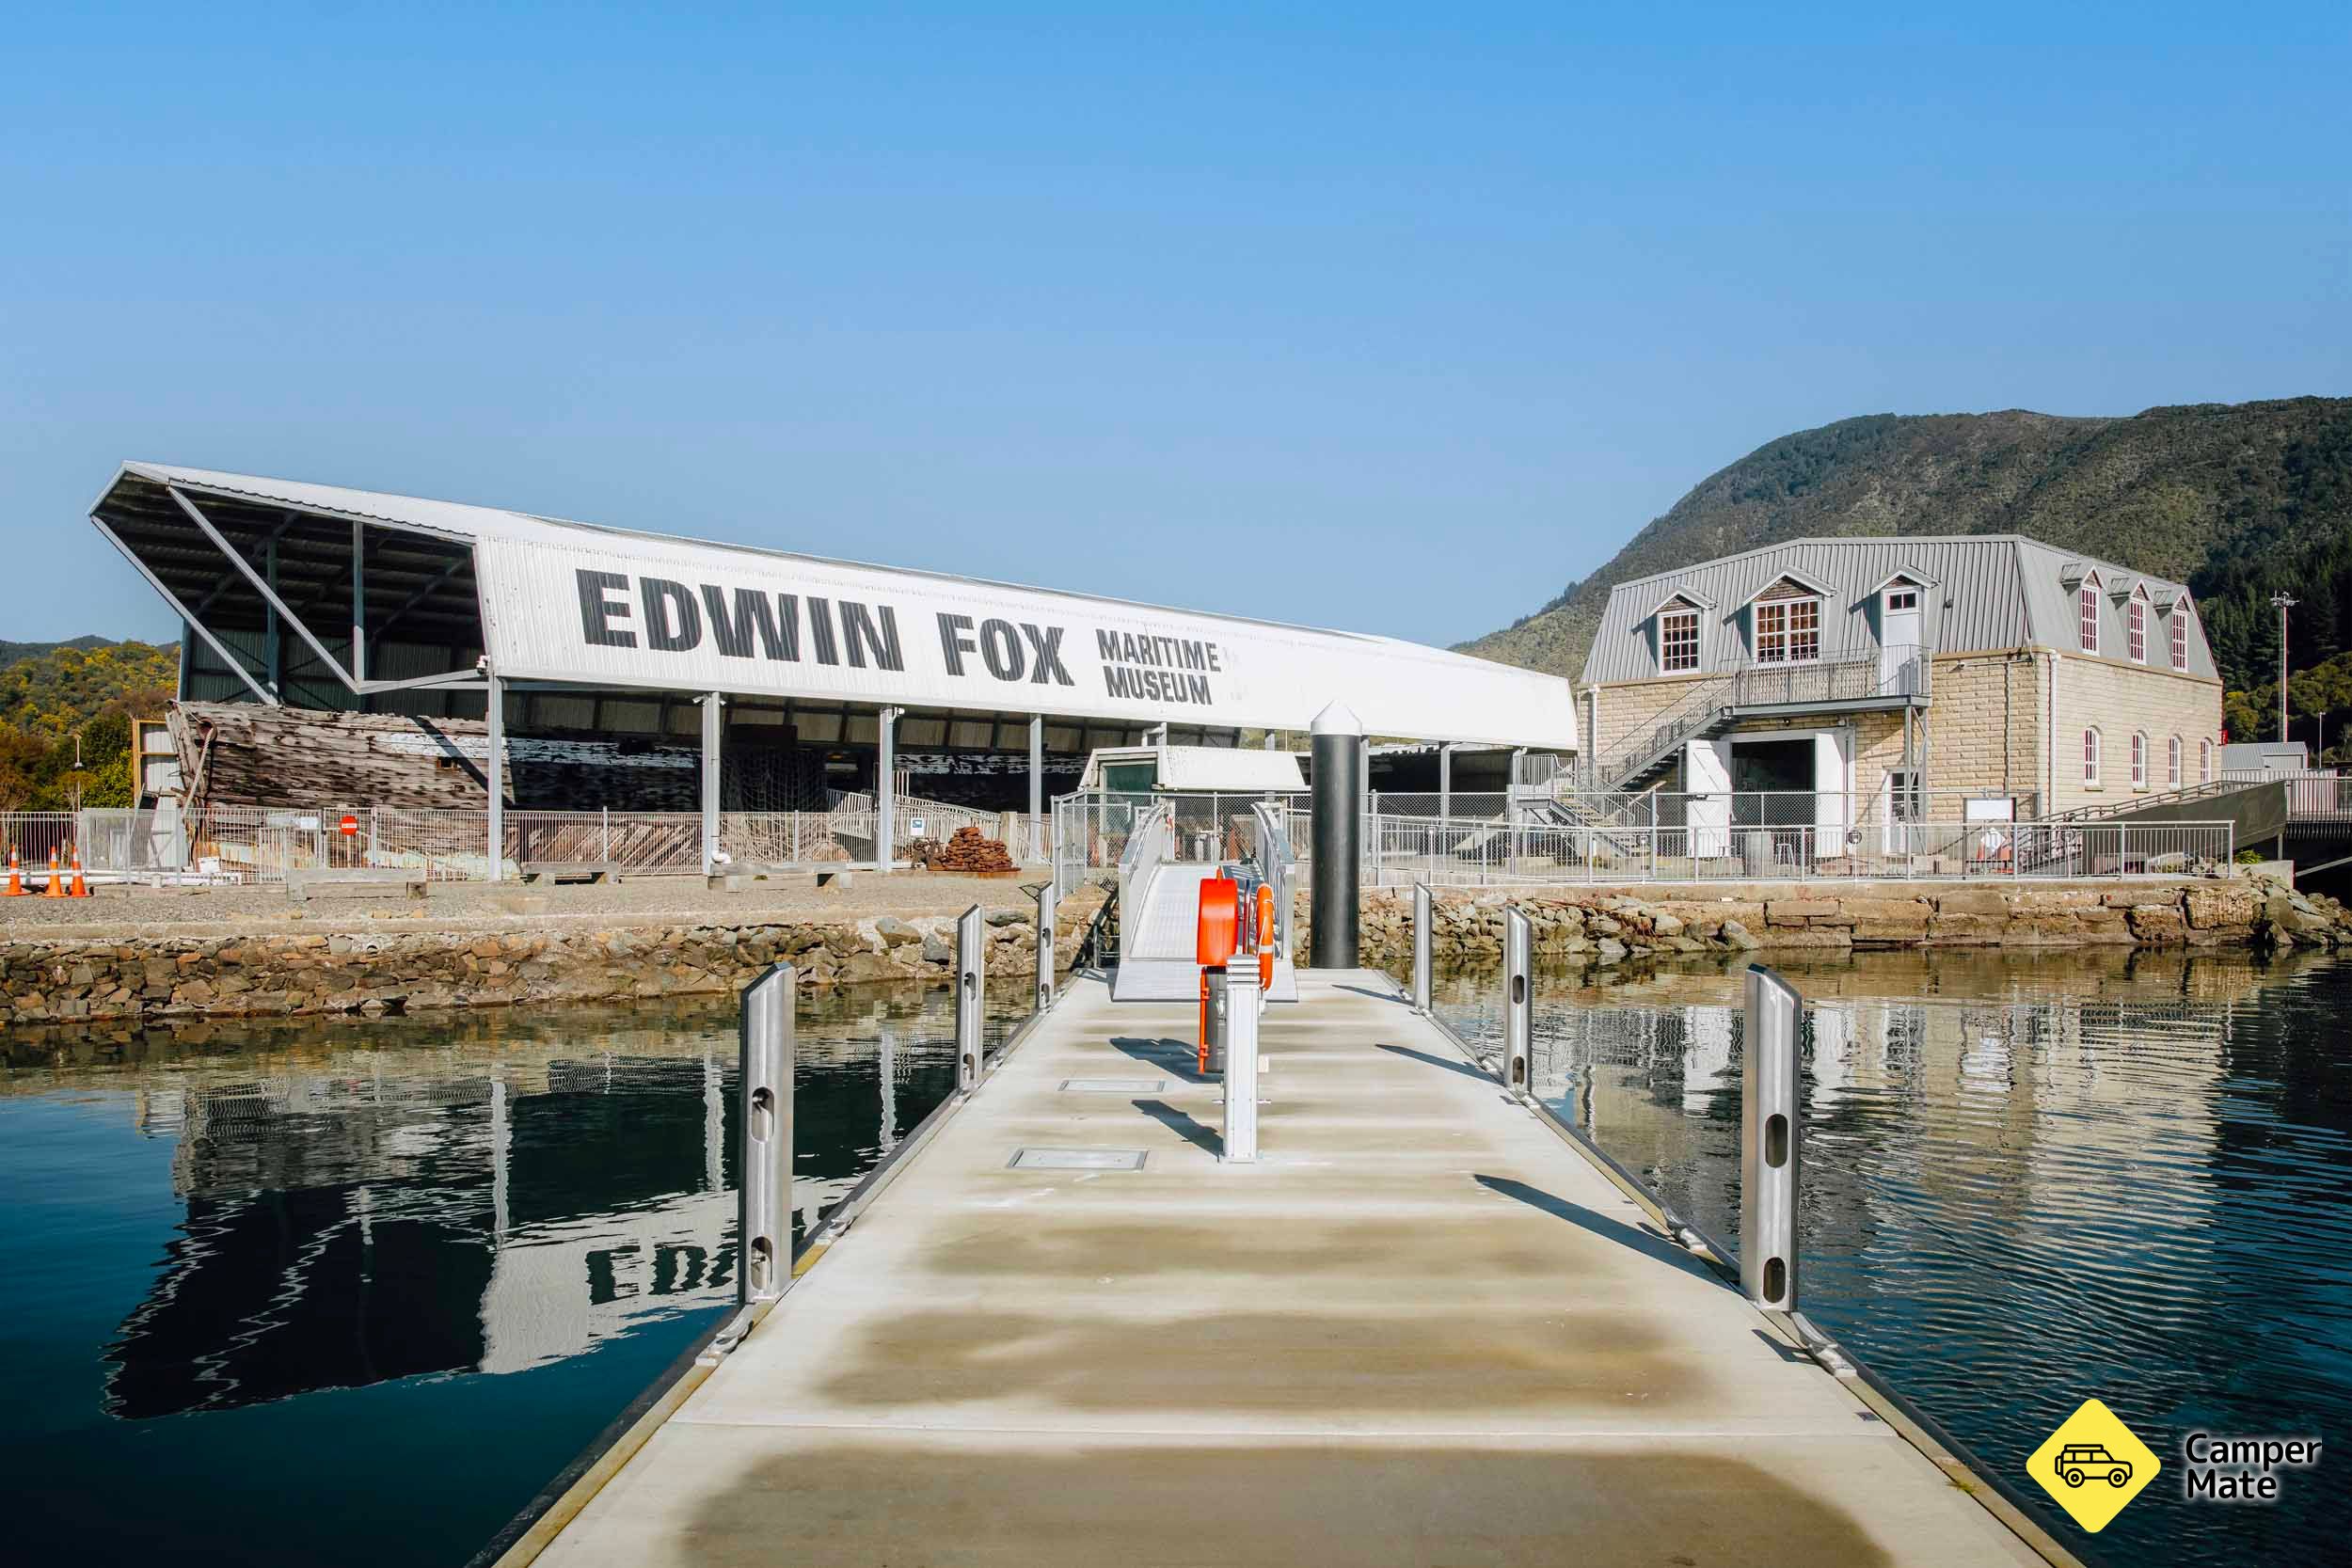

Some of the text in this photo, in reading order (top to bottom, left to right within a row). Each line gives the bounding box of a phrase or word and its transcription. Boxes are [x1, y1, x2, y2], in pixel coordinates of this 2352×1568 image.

[576, 568, 1075, 687] EDWIN FOX
[1096, 627, 1221, 673] MARITIME
[1103, 665, 1212, 705] MUSEUM
